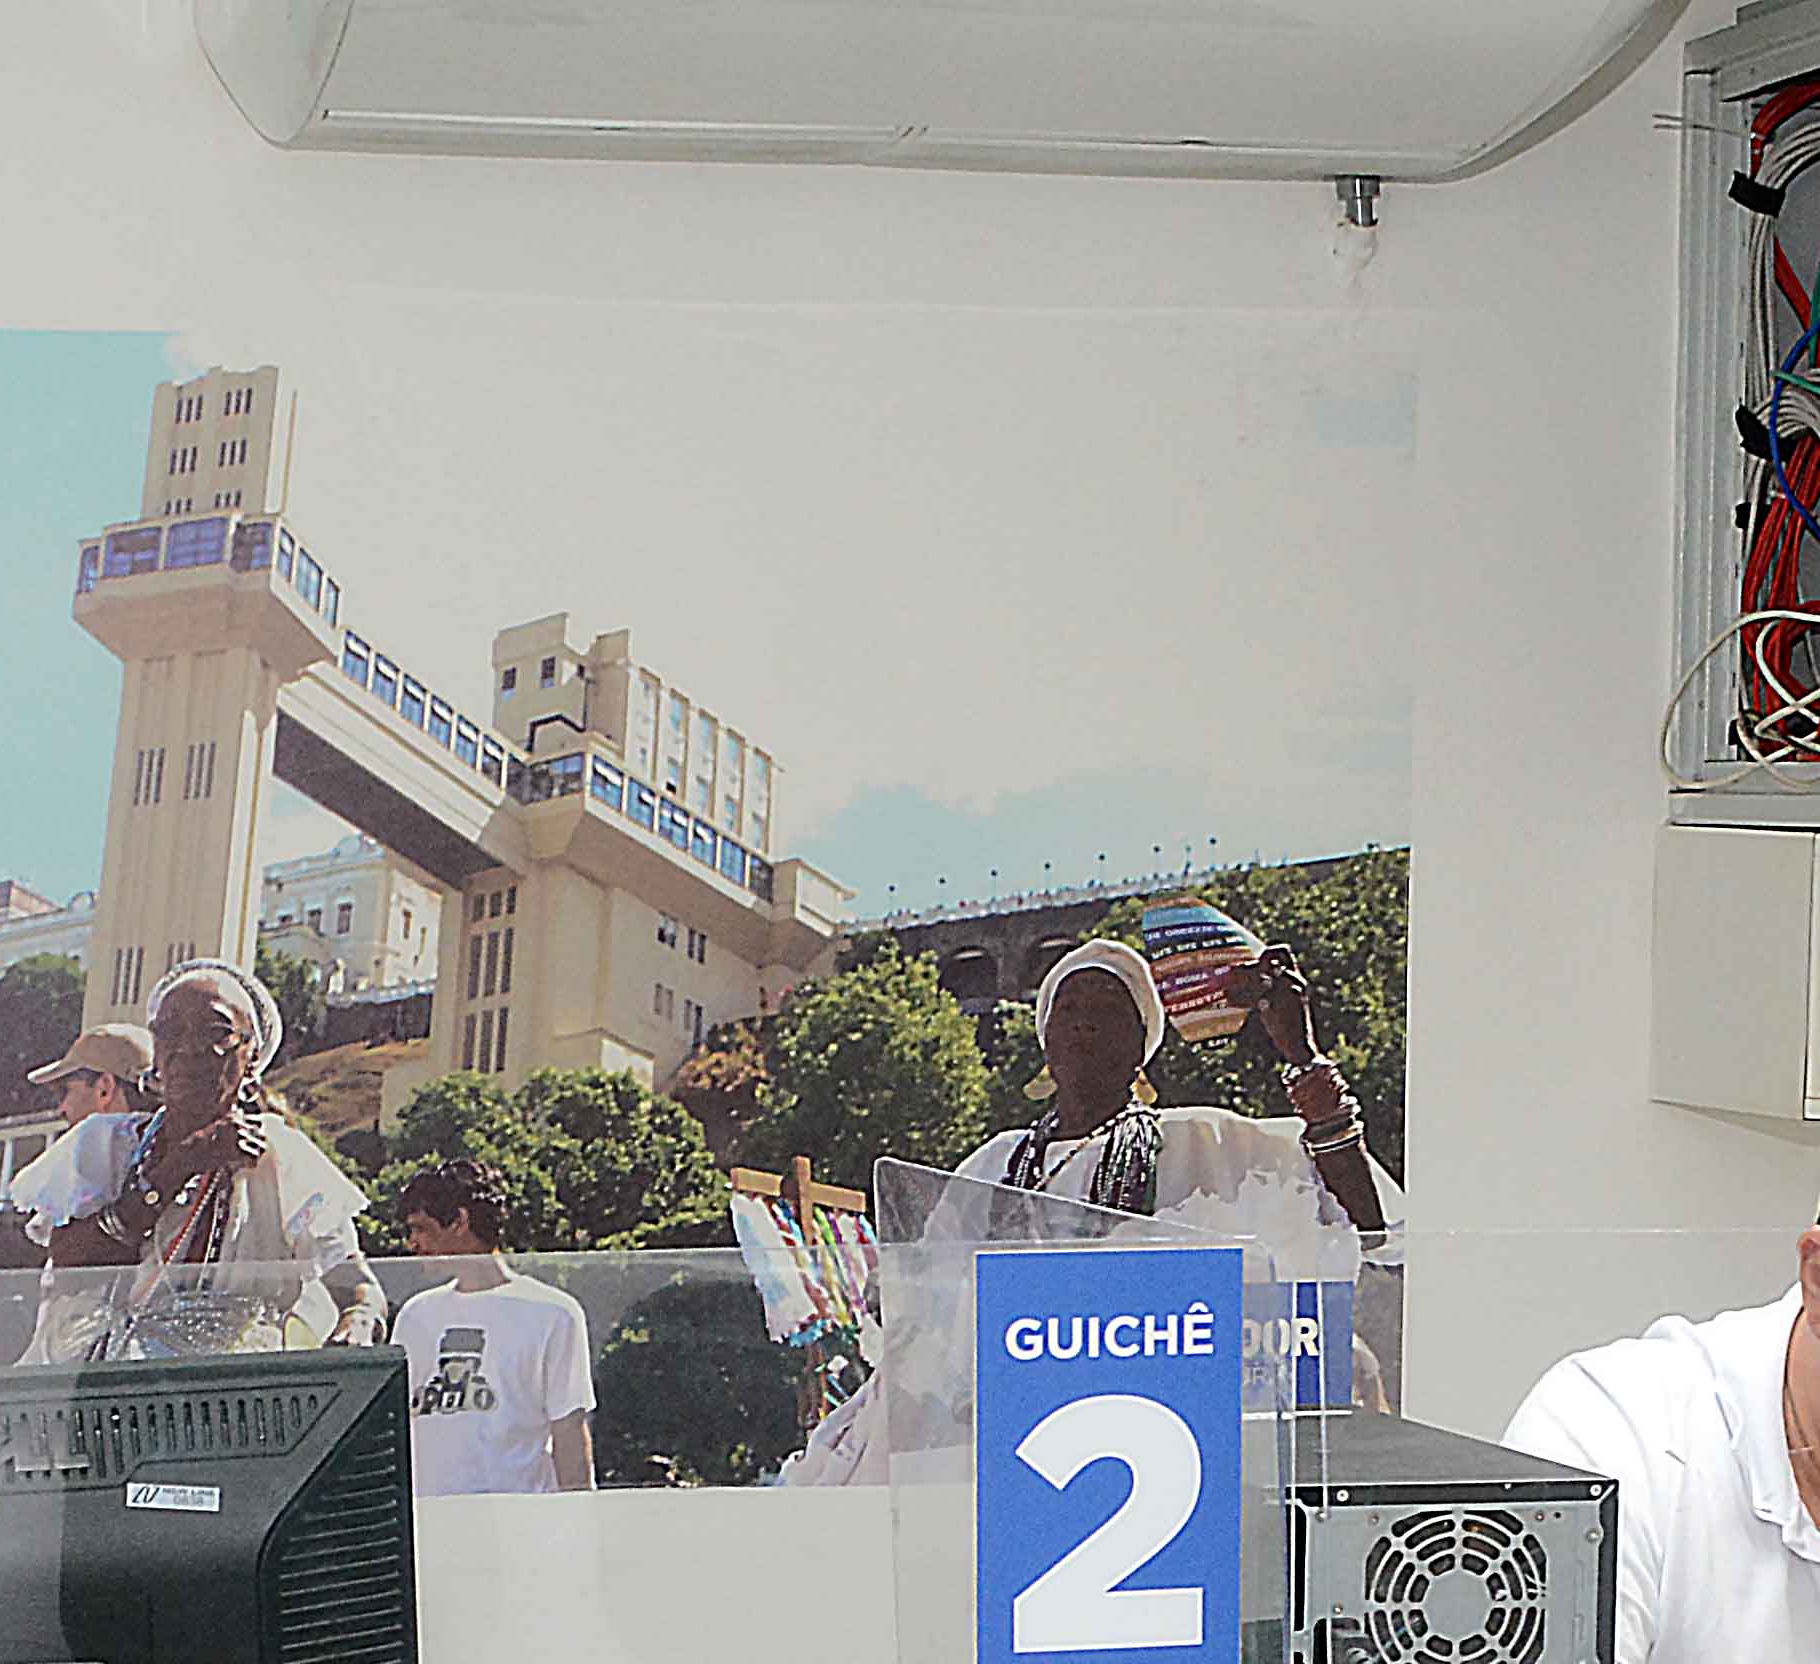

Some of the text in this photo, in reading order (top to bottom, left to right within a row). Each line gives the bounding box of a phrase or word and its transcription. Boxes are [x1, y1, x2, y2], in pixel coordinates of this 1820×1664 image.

[1005, 1302, 1215, 1360] GUICHÊ
[1243, 1317, 1320, 1359] DOR
[1014, 1393, 1204, 1654] 2
